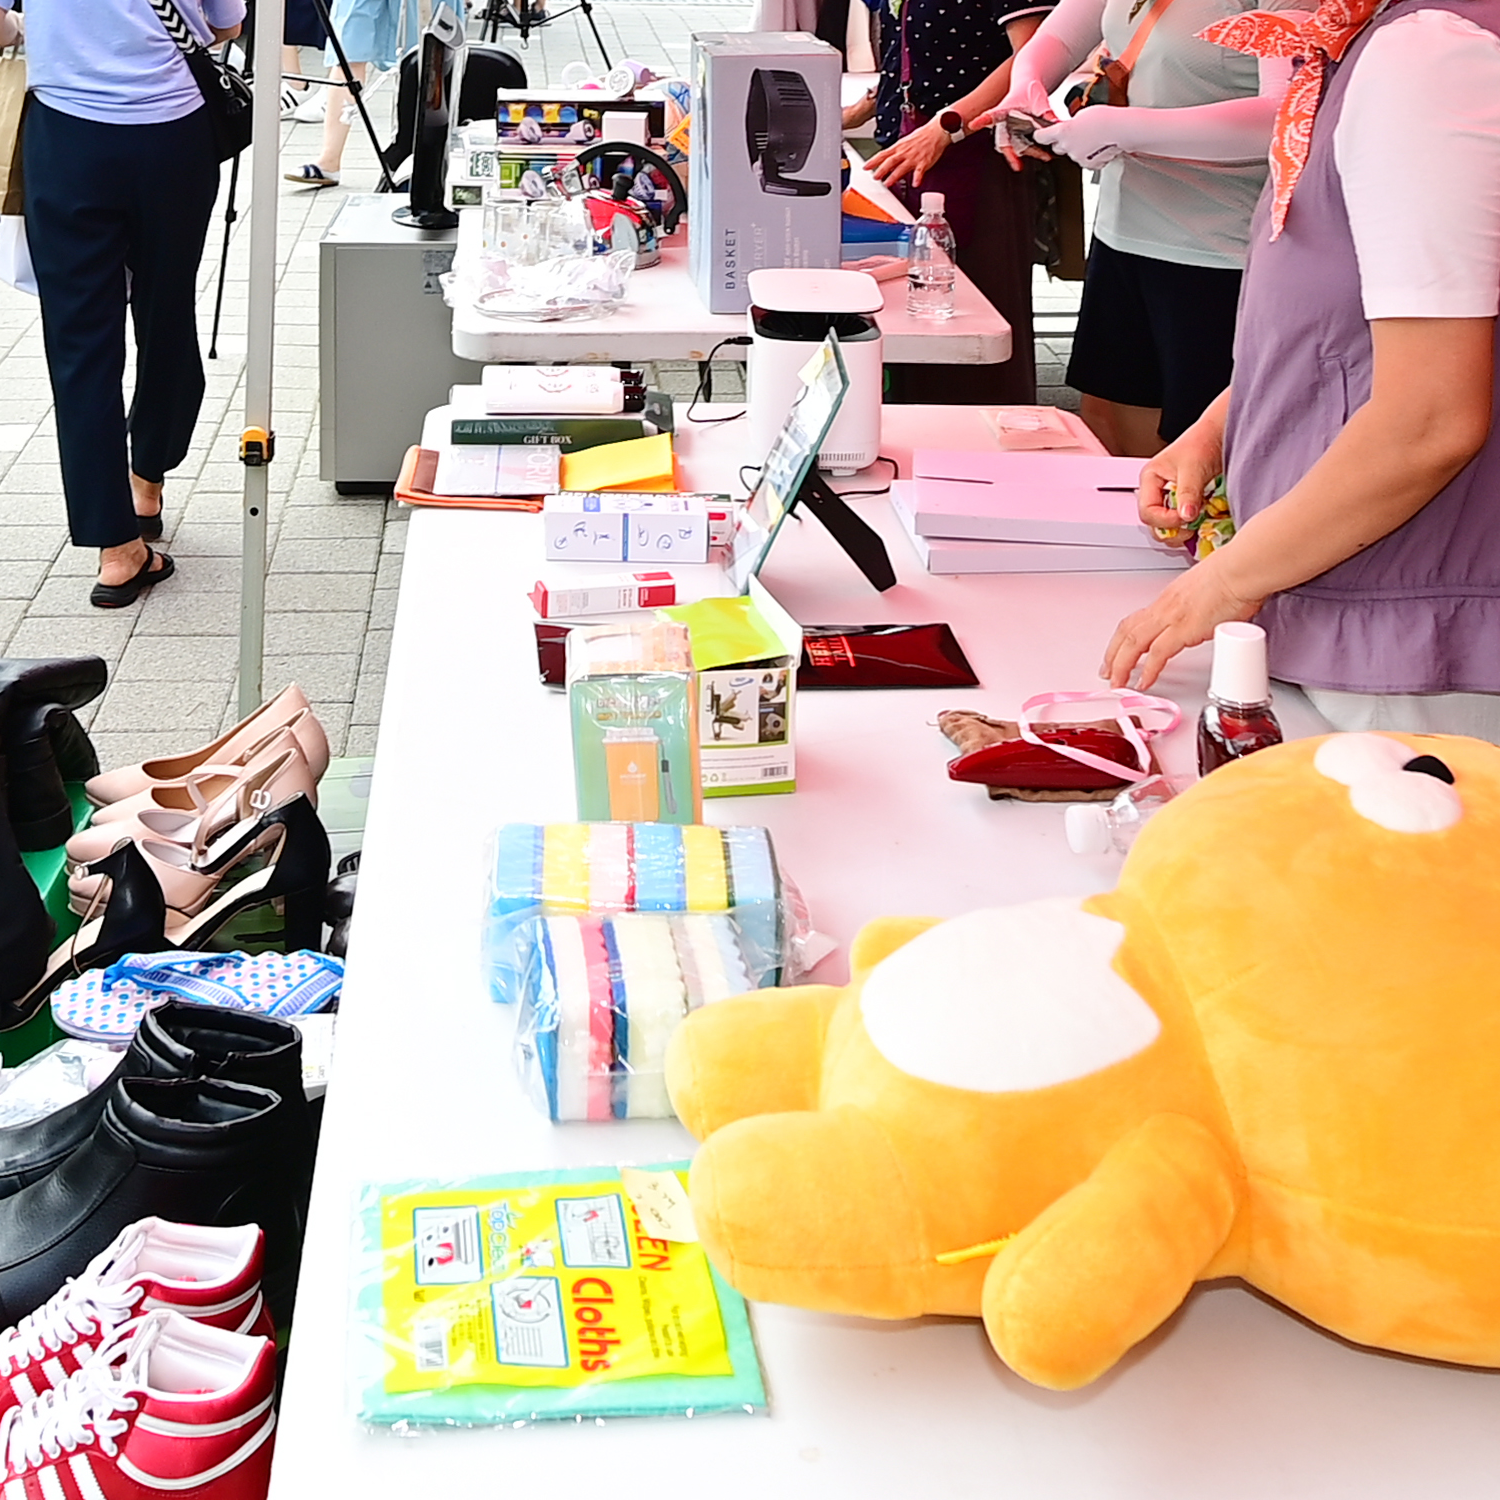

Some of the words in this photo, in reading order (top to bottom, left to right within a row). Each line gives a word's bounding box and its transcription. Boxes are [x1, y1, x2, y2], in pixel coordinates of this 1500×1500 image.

[724, 228, 736, 290] BASKET
[523, 435, 549, 444] GIFT
[551, 435, 572, 444] BOX
[571, 1277, 622, 1373] Cloths
